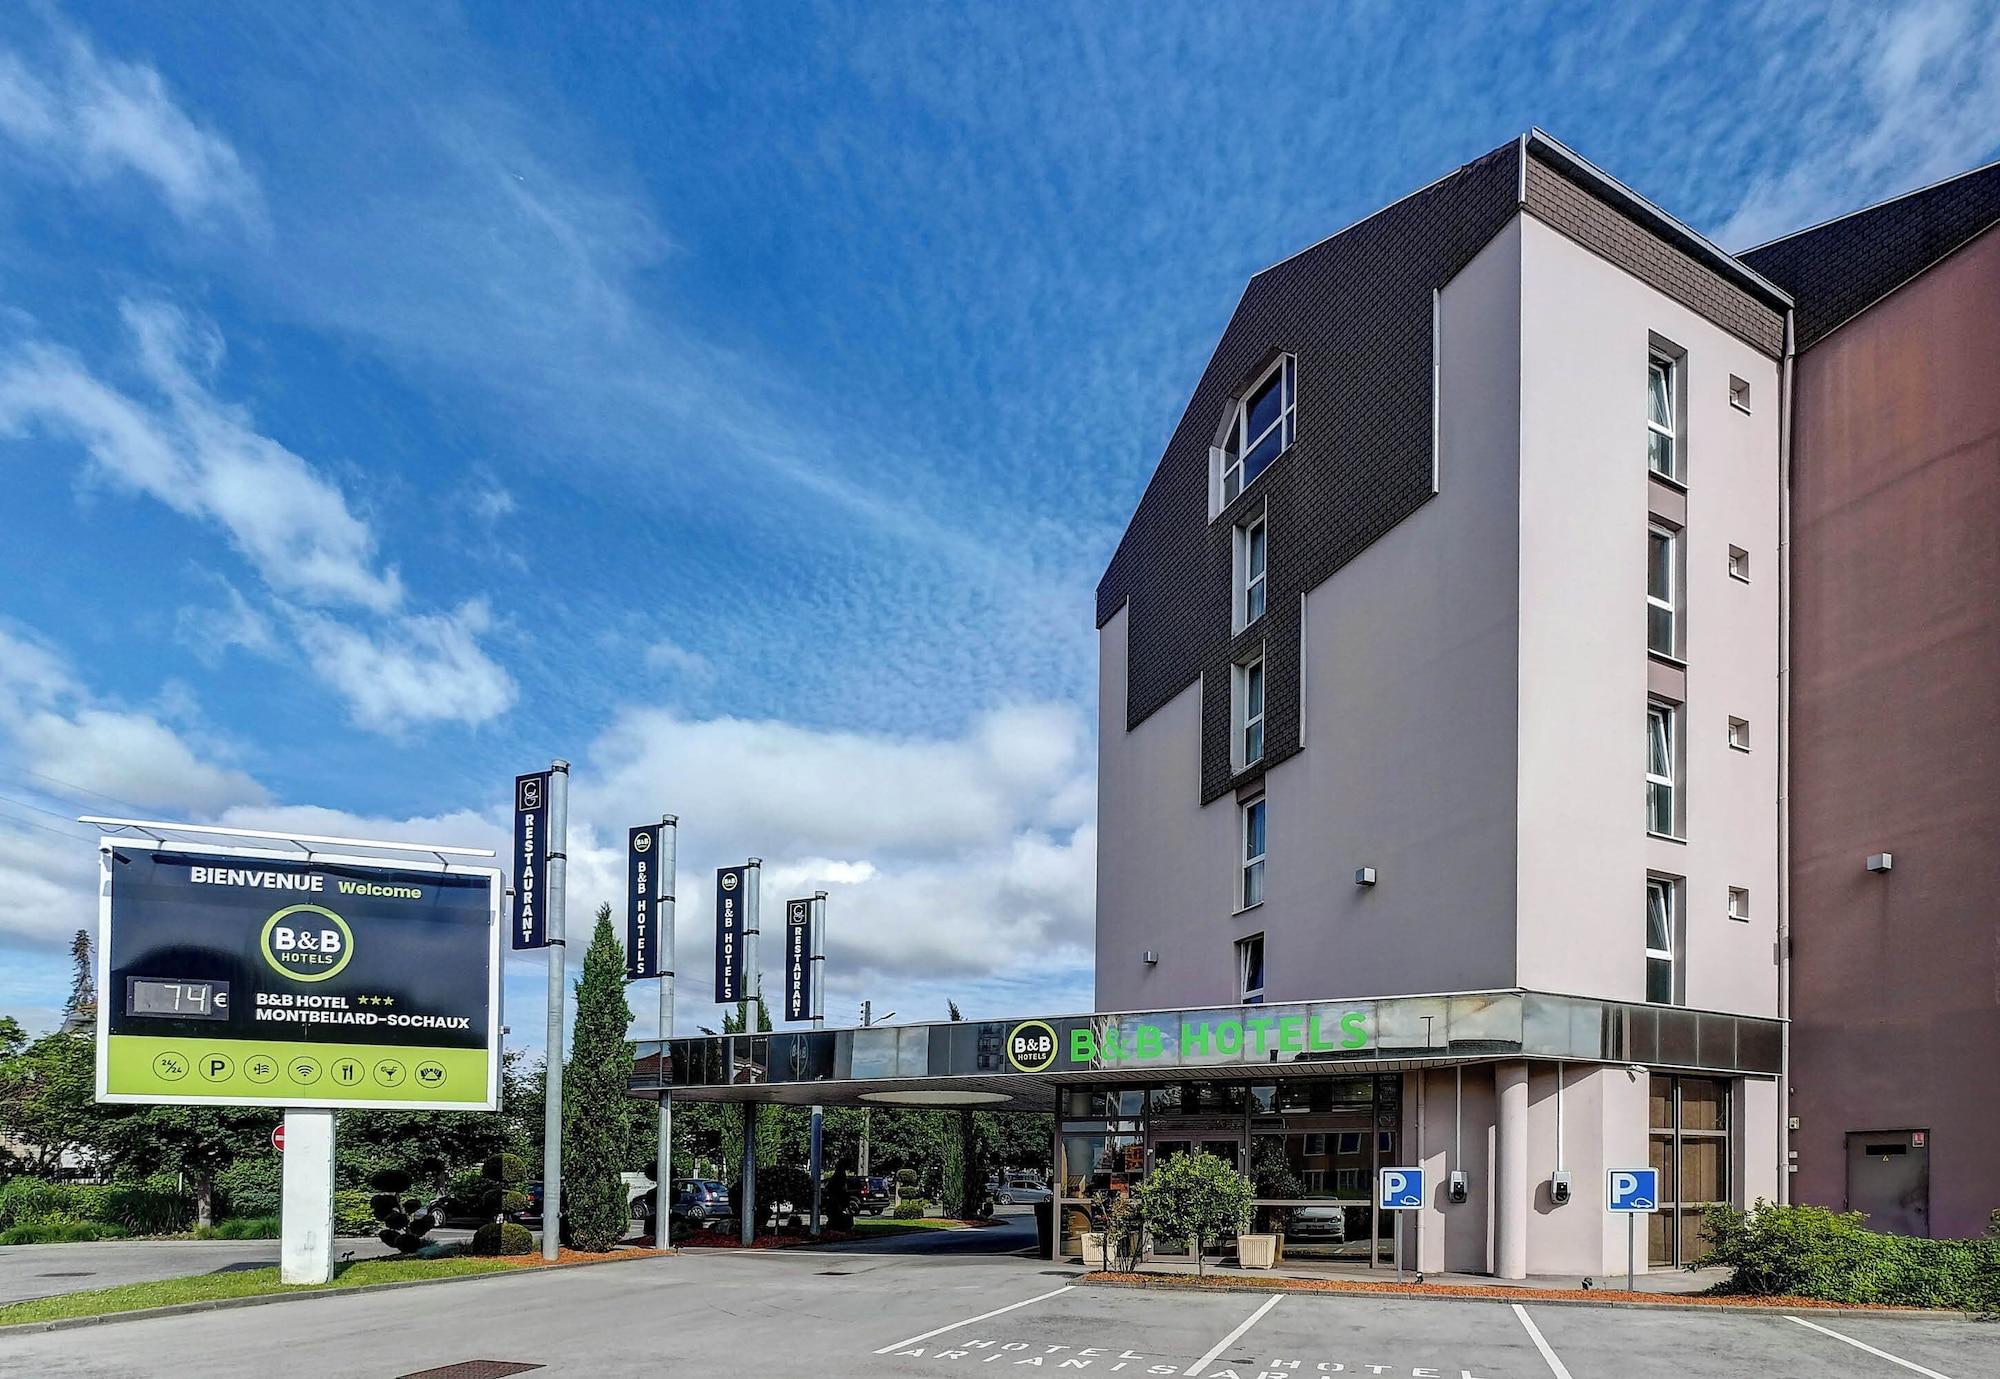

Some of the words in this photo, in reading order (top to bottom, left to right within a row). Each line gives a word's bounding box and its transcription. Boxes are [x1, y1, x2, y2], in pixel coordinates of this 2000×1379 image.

[191, 866, 324, 892] BIENVENUE
[338, 880, 422, 899] Welcome
[522, 814, 534, 943] RESTAURANT
[637, 861, 648, 894] B&B
[724, 898, 734, 928] B&B
[275, 926, 341, 953] B&B
[636, 899, 647, 974] HOTELS
[281, 952, 333, 964] HOTELS
[724, 932, 733, 999] HOTELS
[792, 927, 802, 1018] RESTAURANT
[163, 984, 207, 1012] 74
[256, 993, 294, 1007] B&B
[297, 995, 350, 1009] HOTEL
[256, 1009, 471, 1030] MONTBELIARD-SOCHAUX
[1014, 1036, 1051, 1054] B&B
[1070, 1025, 1164, 1063] B&B
[1181, 1013, 1368, 1057] HOTELS
[211, 1060, 226, 1077] P
[1017, 1053, 1047, 1061] HOTELS
[1384, 1172, 1407, 1202] P
[1612, 1173, 1638, 1204] P
[895, 1348, 1179, 1375] ARIANIS
[961, 1339, 1144, 1360] HOTEL
[1270, 1359, 1487, 1379] HOTEL
